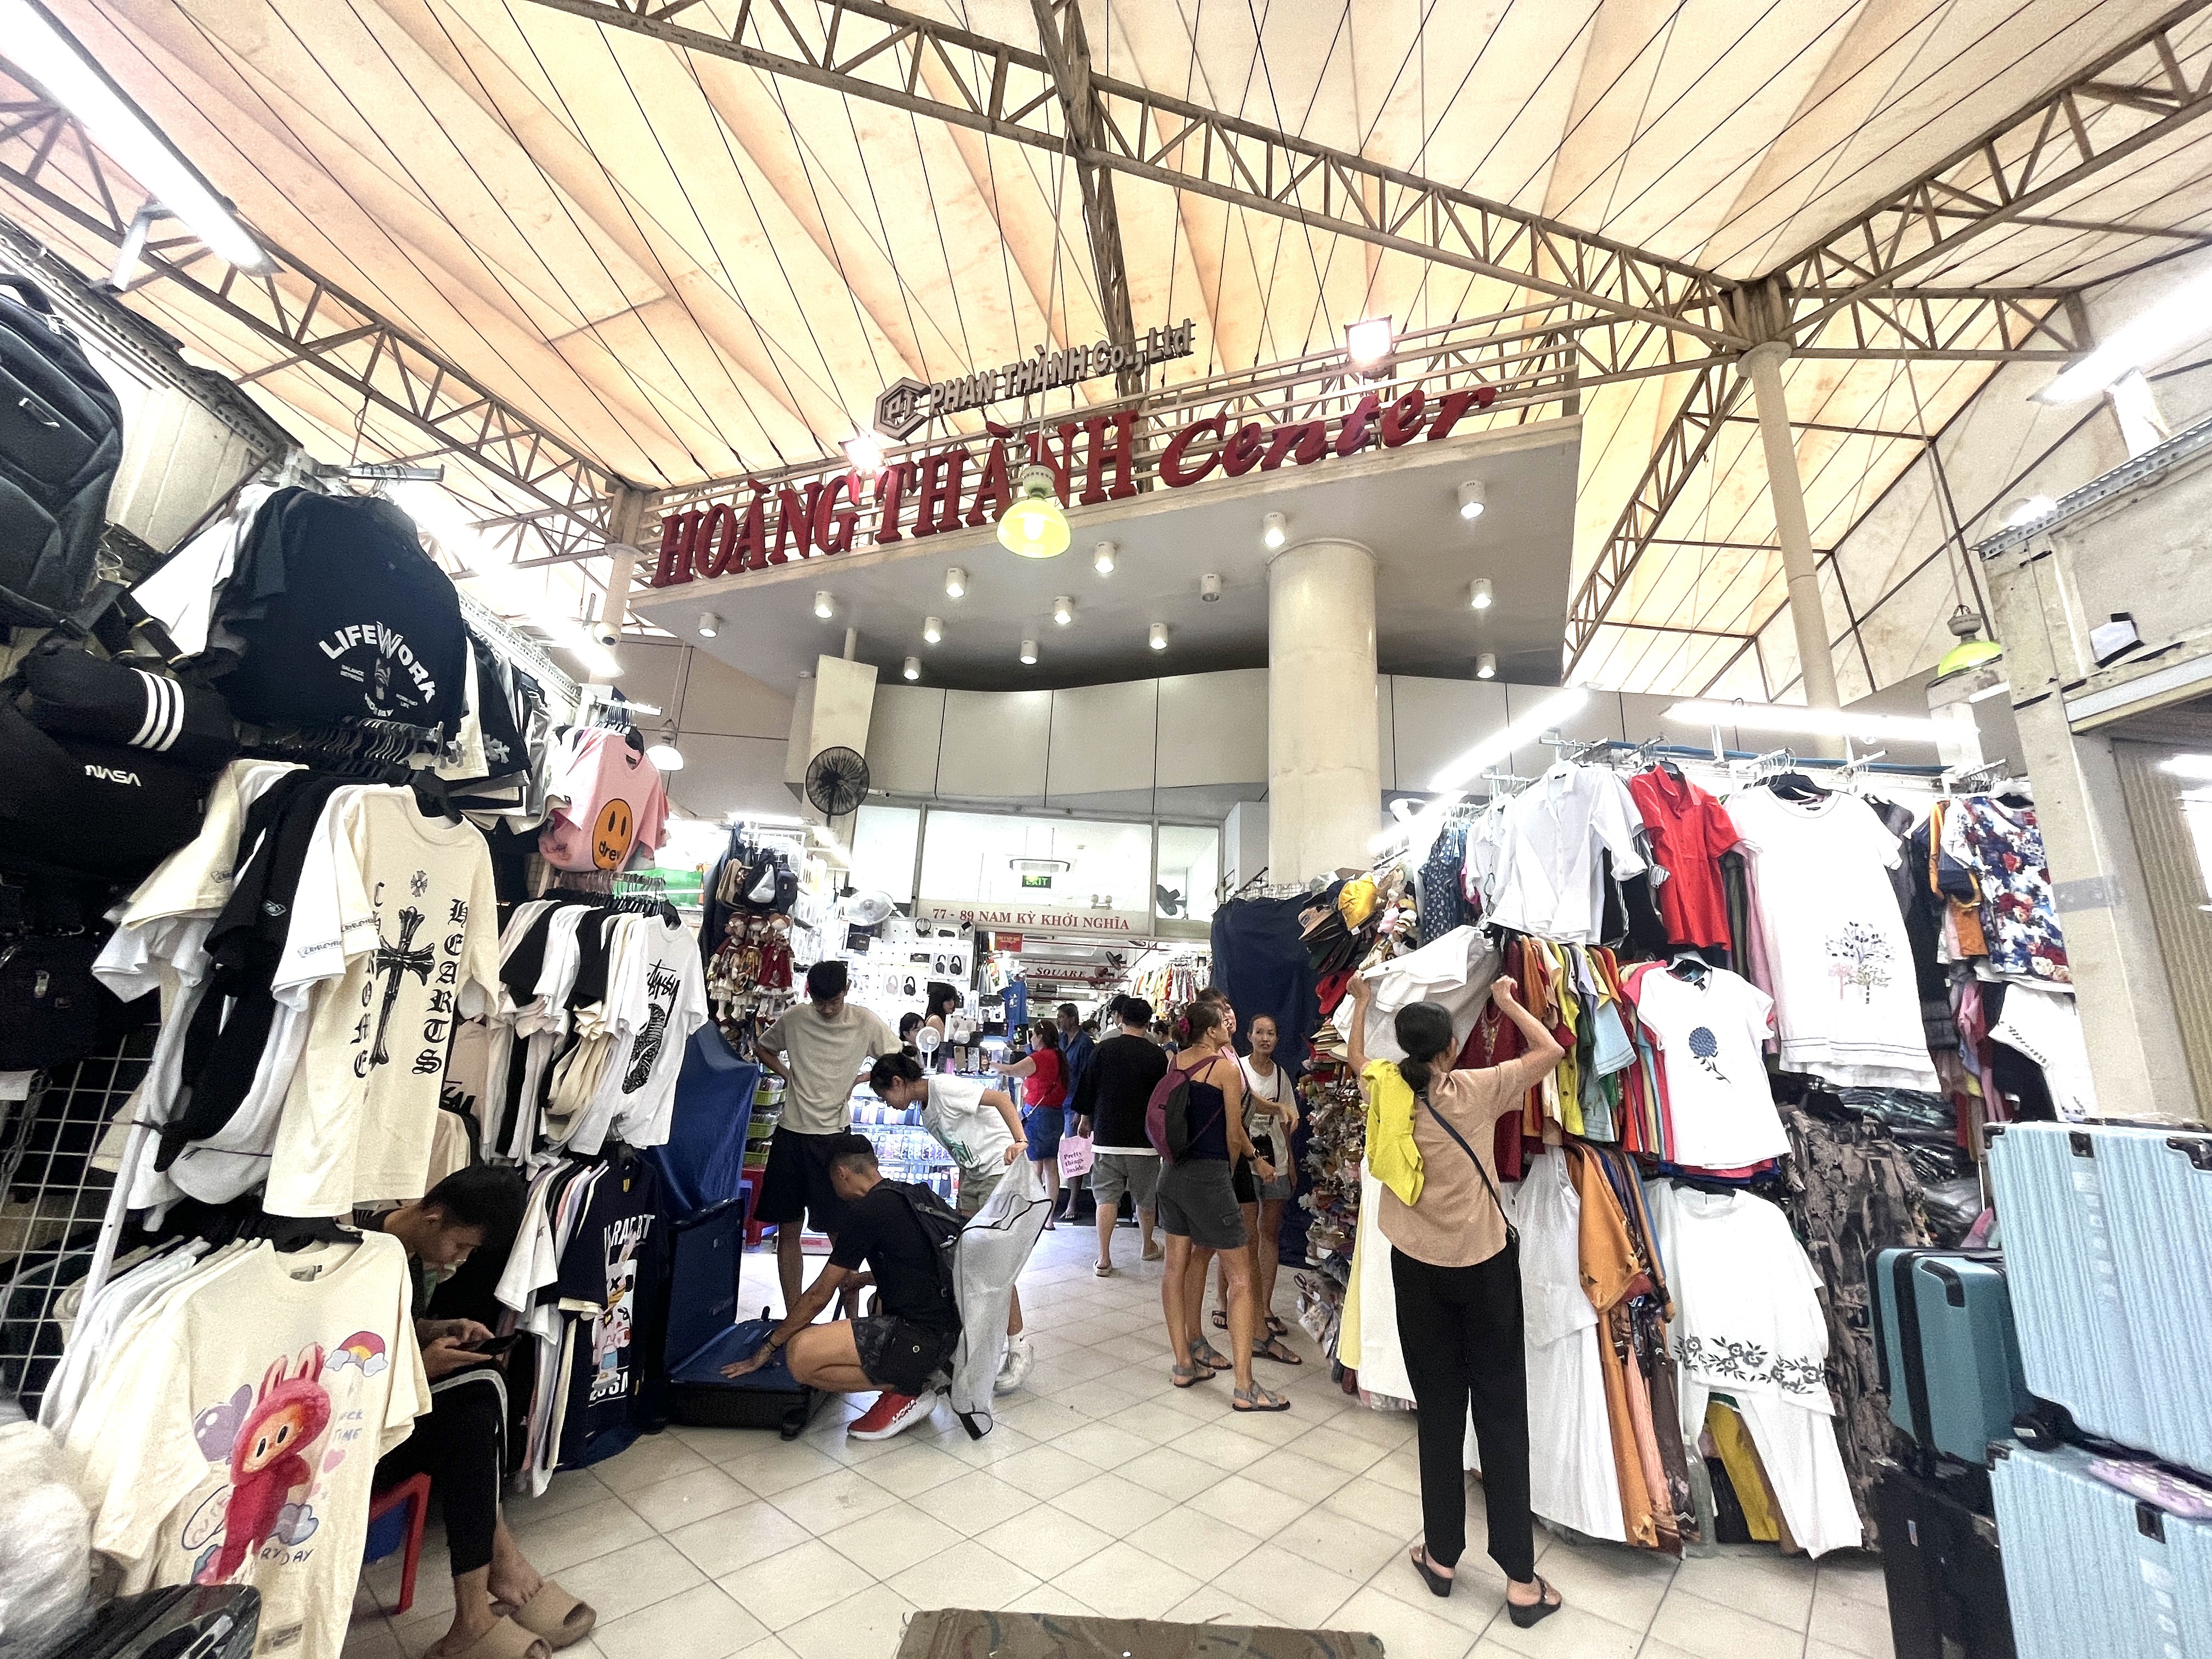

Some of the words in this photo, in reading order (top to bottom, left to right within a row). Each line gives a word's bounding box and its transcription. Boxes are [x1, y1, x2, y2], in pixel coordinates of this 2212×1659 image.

[930, 369, 997, 415] PHAN
[1003, 344, 1088, 398] THÀNH
[1092, 340, 1147, 376] Co.,
[1147, 318, 1193, 365] Ltd
[652, 475, 861, 589] HOÀNG
[874, 408, 1141, 545] THÀNH
[1158, 386, 1497, 488] Center
[319, 620, 436, 703] LIFEWORK
[84, 765, 142, 787] NASA
[932, 909, 947, 919] 77
[960, 910, 974, 921] 89
[979, 911, 1012, 923] NAM
[1017, 910, 1036, 924] KỲ
[1041, 912, 1079, 927] KHỞI
[1083, 916, 1130, 930] NGHĨA
[411, 899, 469, 1075] HEARTS
[1065, 1159, 1084, 1167] things
[892, 1399, 918, 1423] HOKA
